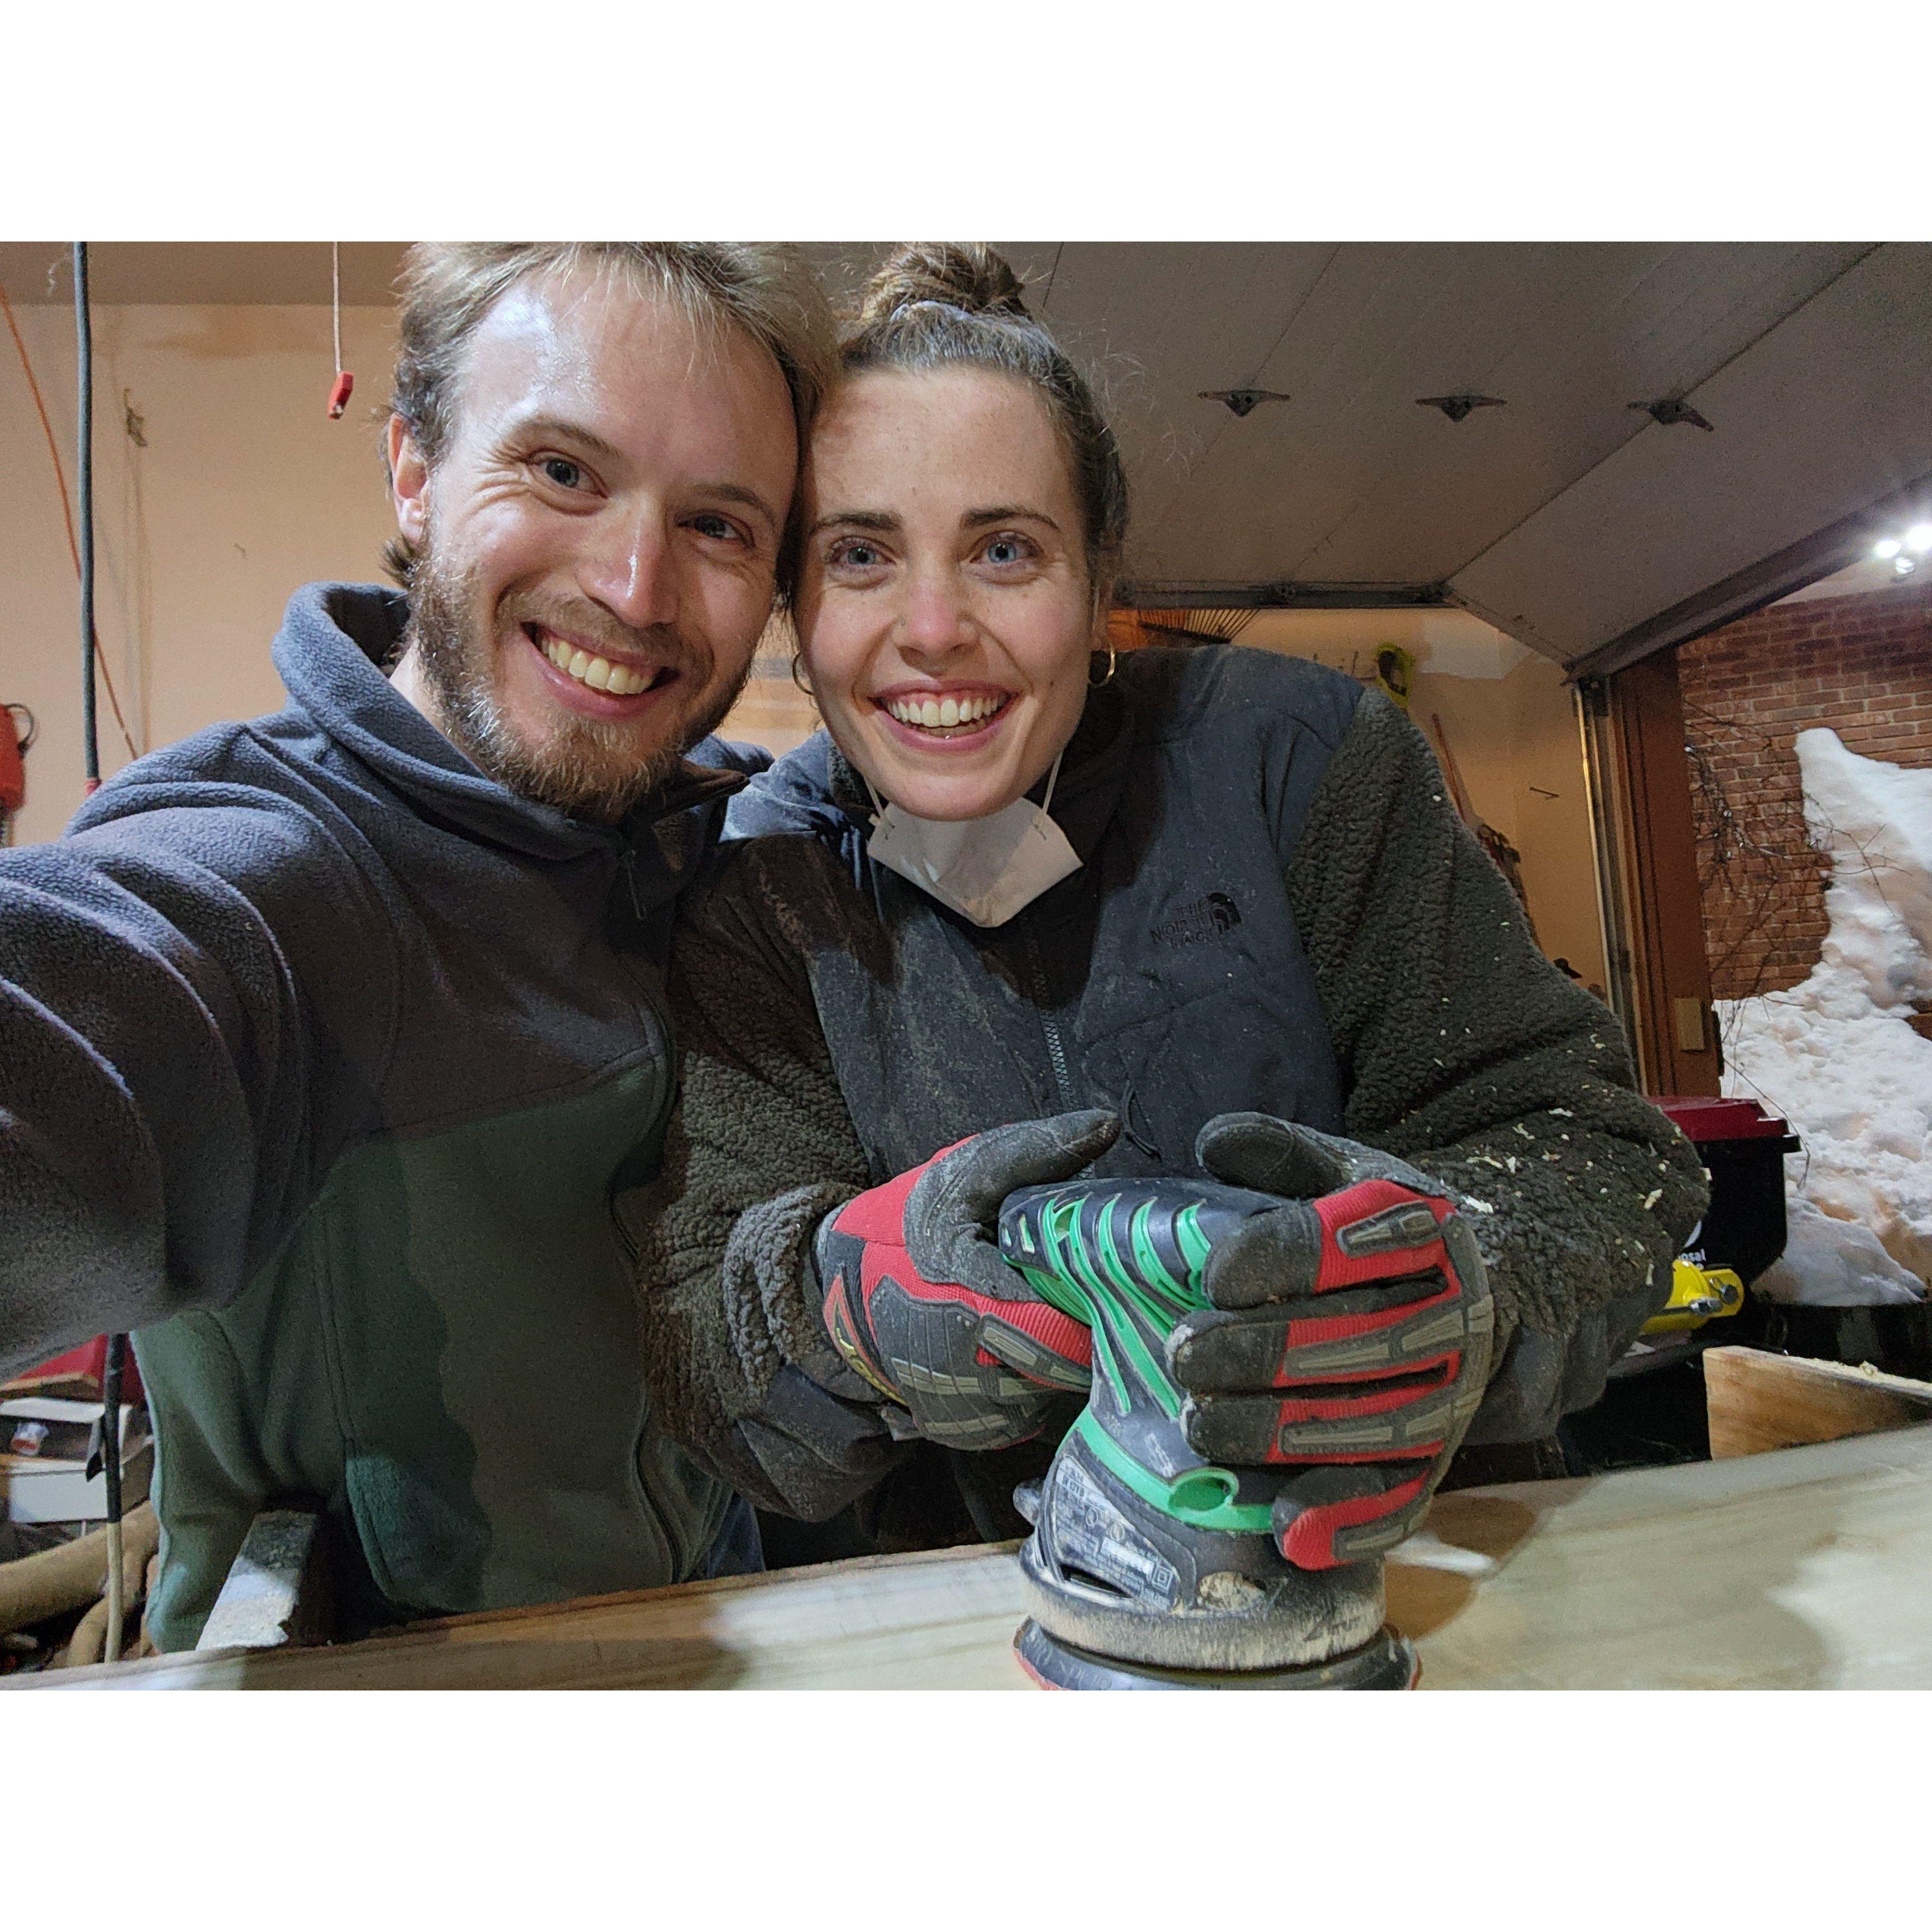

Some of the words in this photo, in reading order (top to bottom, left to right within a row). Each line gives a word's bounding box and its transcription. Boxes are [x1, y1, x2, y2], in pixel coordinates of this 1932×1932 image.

[1175, 899, 1206, 916] THE
[1149, 915, 1208, 945] NORTH
[1167, 927, 1214, 950] FACE
